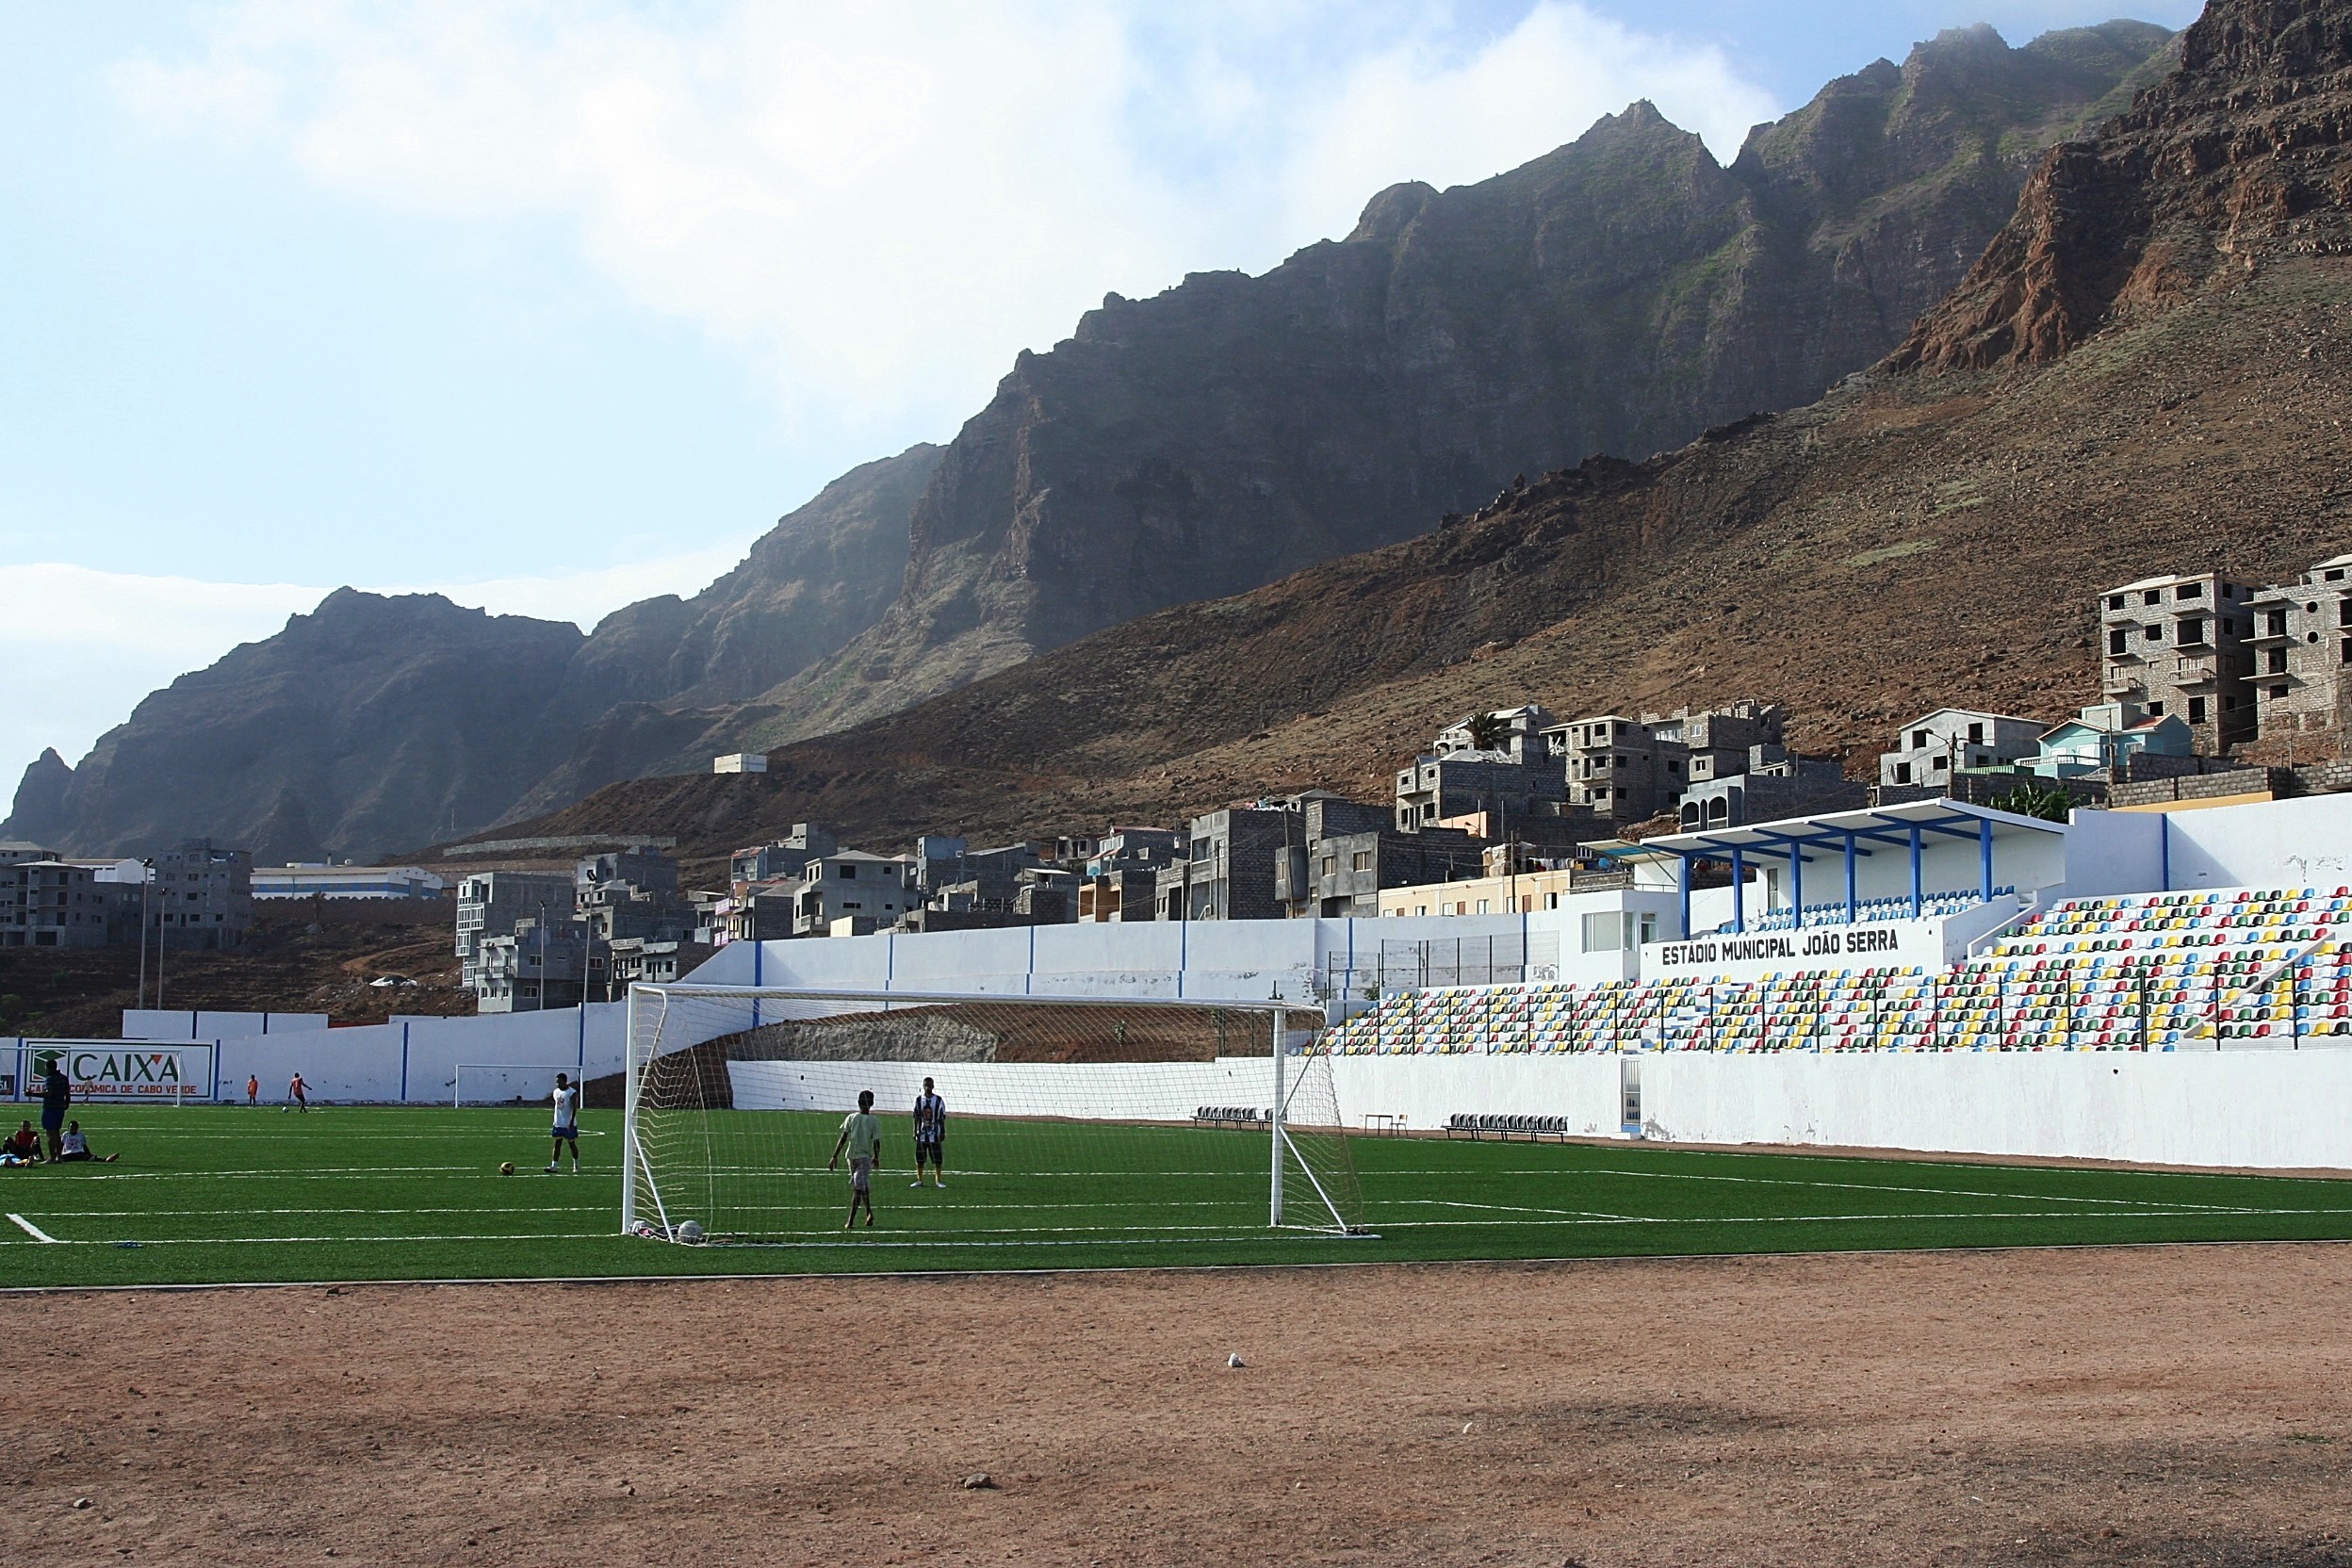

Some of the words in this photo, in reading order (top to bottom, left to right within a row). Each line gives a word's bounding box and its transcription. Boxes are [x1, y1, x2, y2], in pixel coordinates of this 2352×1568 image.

[1662, 941, 1717, 966] ESTÁDIO
[1722, 938, 1796, 962] MUNICIPAL
[1802, 930, 1840, 956] JOÃO
[1846, 928, 1899, 954] SERRA
[73, 1054, 179, 1083] CAIXA
[120, 1085, 134, 1094] DE
[138, 1085, 163, 1094] CABO
